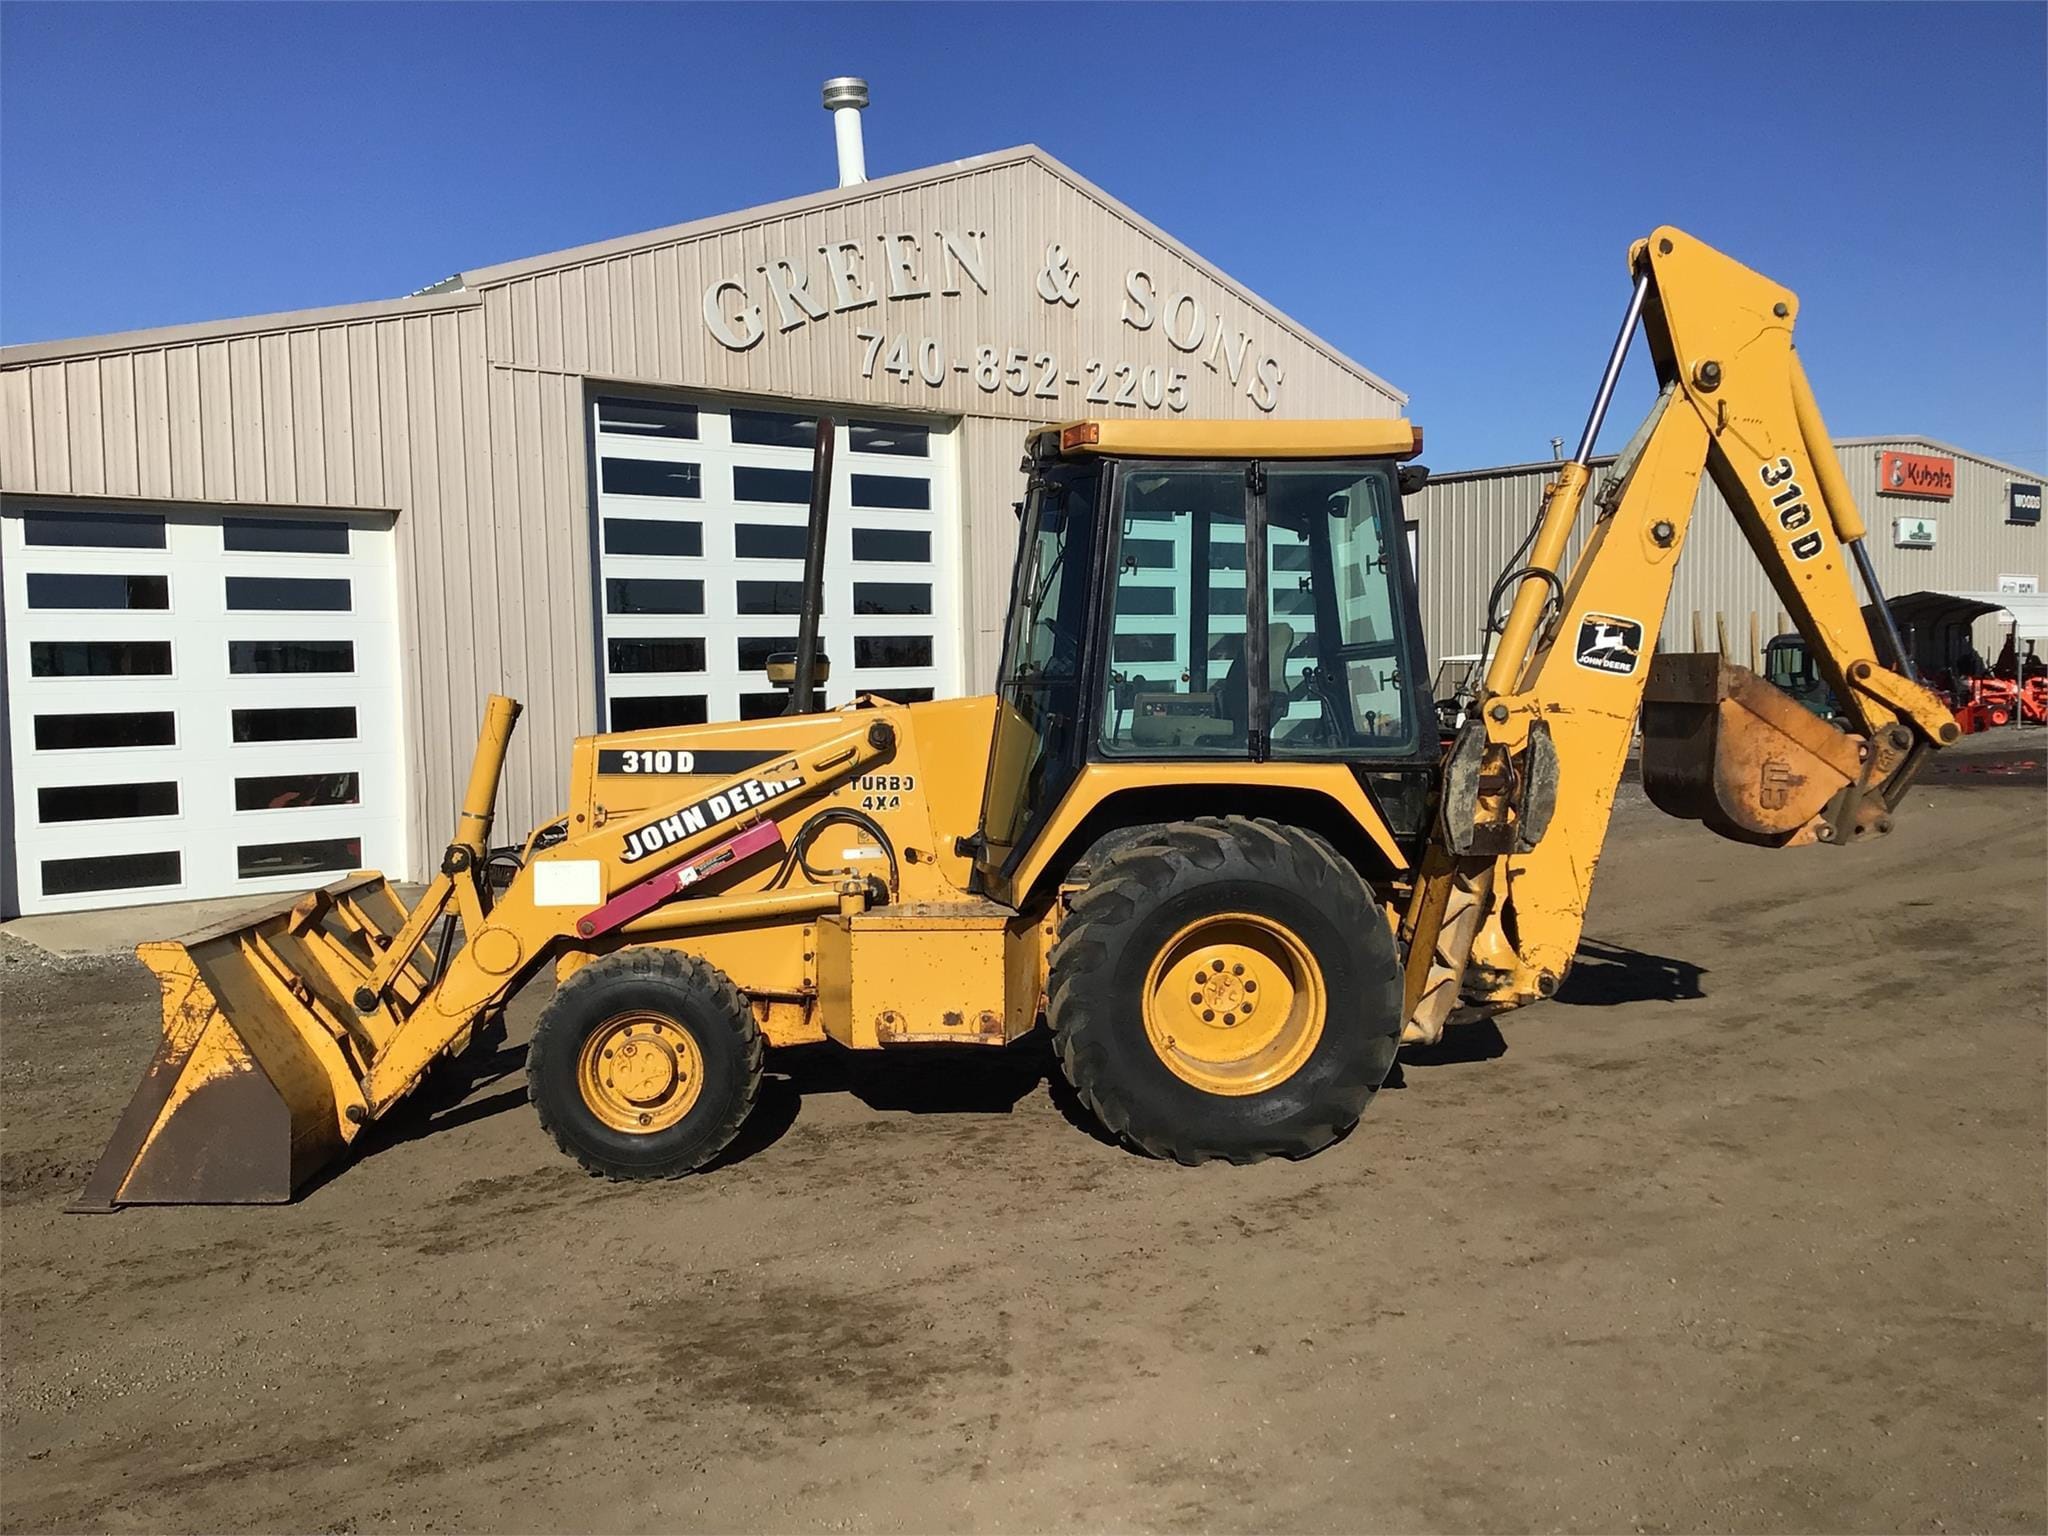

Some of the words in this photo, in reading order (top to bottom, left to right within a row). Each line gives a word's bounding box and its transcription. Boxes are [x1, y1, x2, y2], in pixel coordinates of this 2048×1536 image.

[702, 229, 988, 352] GREEN
[1036, 242, 1080, 307] &
[1122, 268, 1285, 413] SONS
[857, 328, 1190, 412] 740-852-2205
[1907, 462, 1952, 489] Kubota
[1578, 655, 1602, 666] JOHN
[1603, 660, 1632, 671] DEERE
[622, 750, 673, 773] 310
[676, 751, 694, 773] D
[620, 806, 706, 860] JOHN
